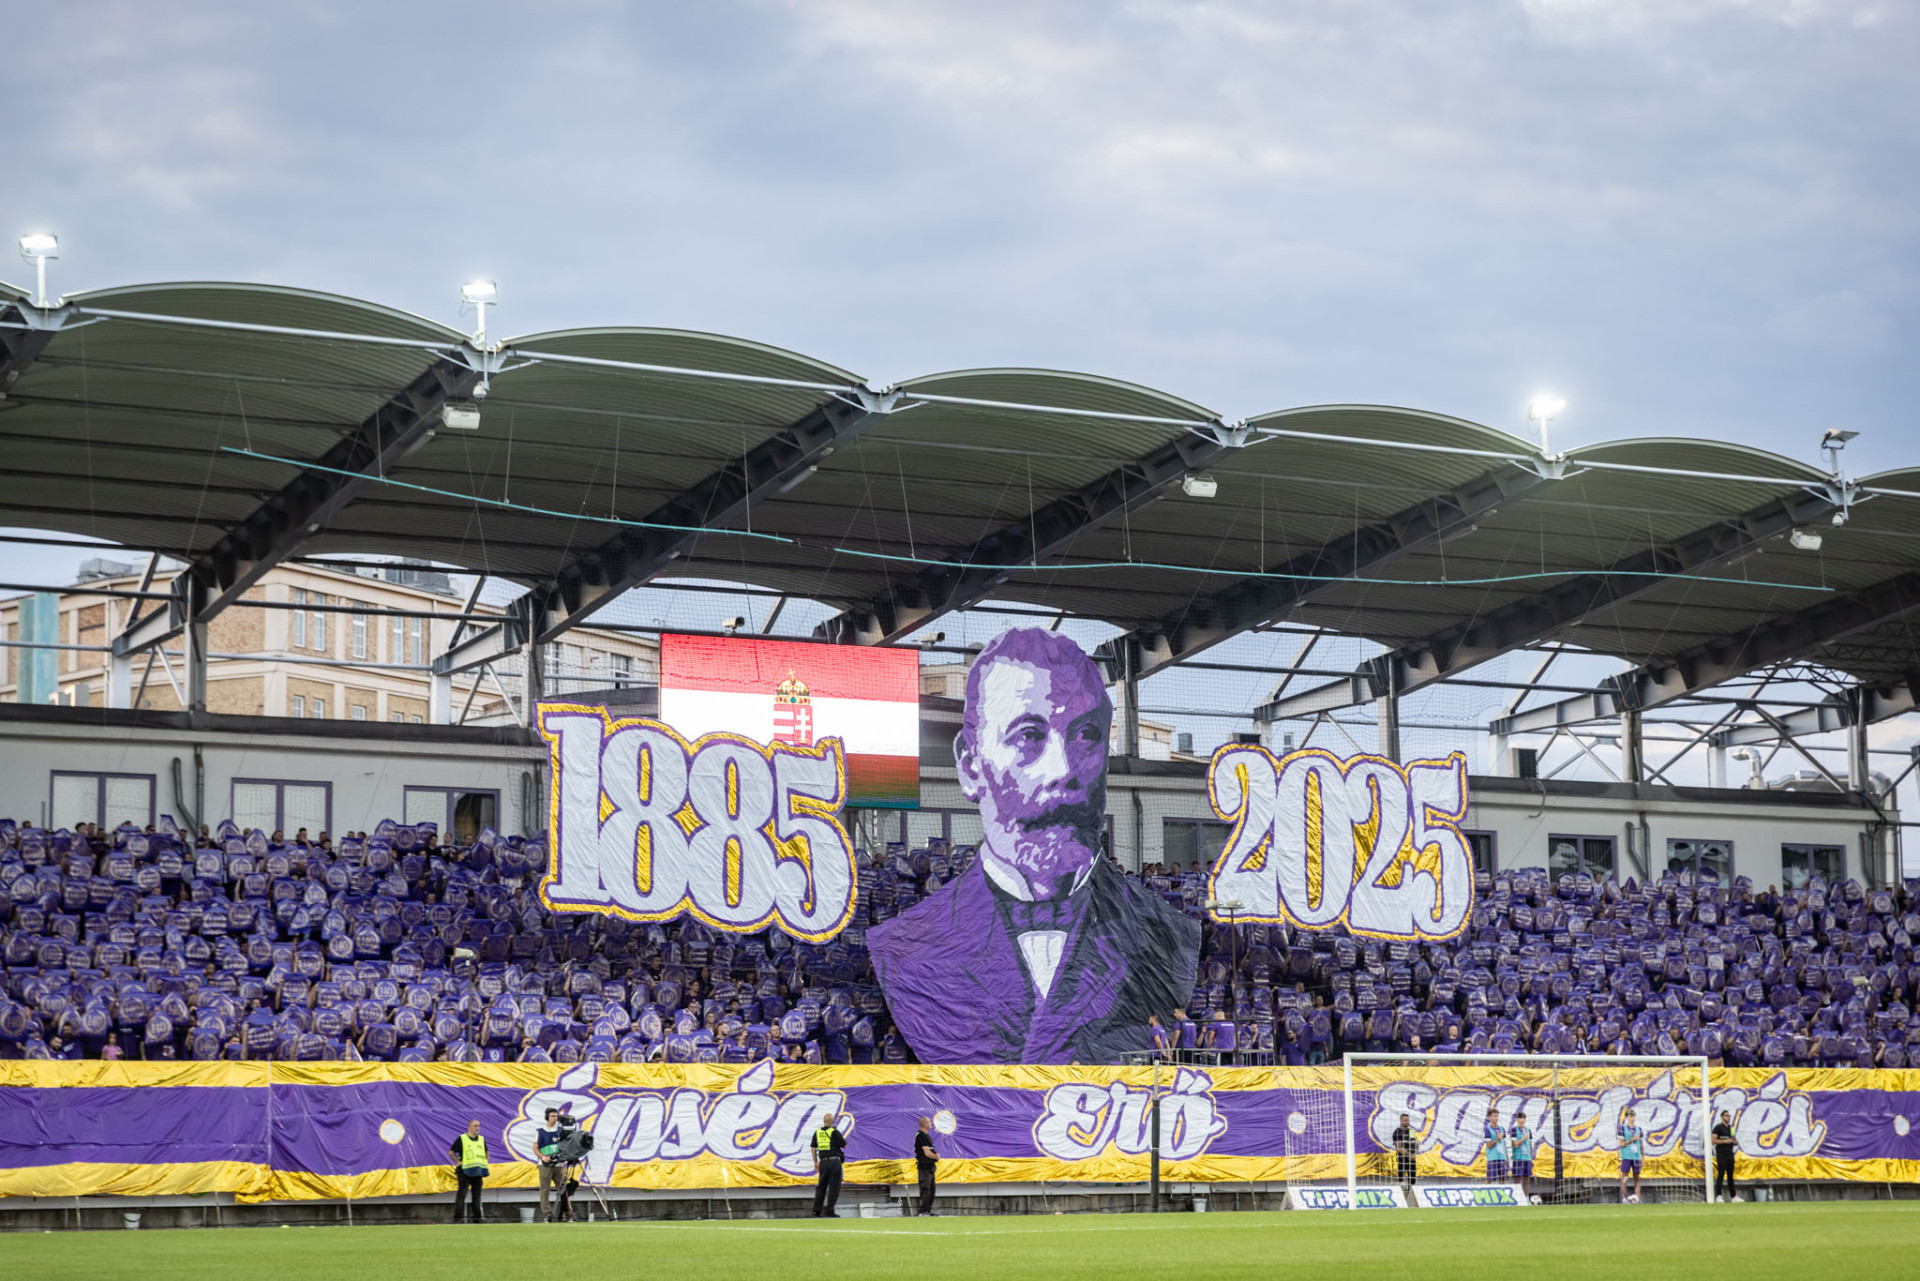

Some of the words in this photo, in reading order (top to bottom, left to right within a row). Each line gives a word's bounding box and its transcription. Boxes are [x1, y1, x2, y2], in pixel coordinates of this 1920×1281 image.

[537, 703, 855, 940] 1885
[1208, 744, 1474, 941] 2025
[505, 1059, 852, 1184] Épség
[1034, 1067, 1227, 1160] Erő
